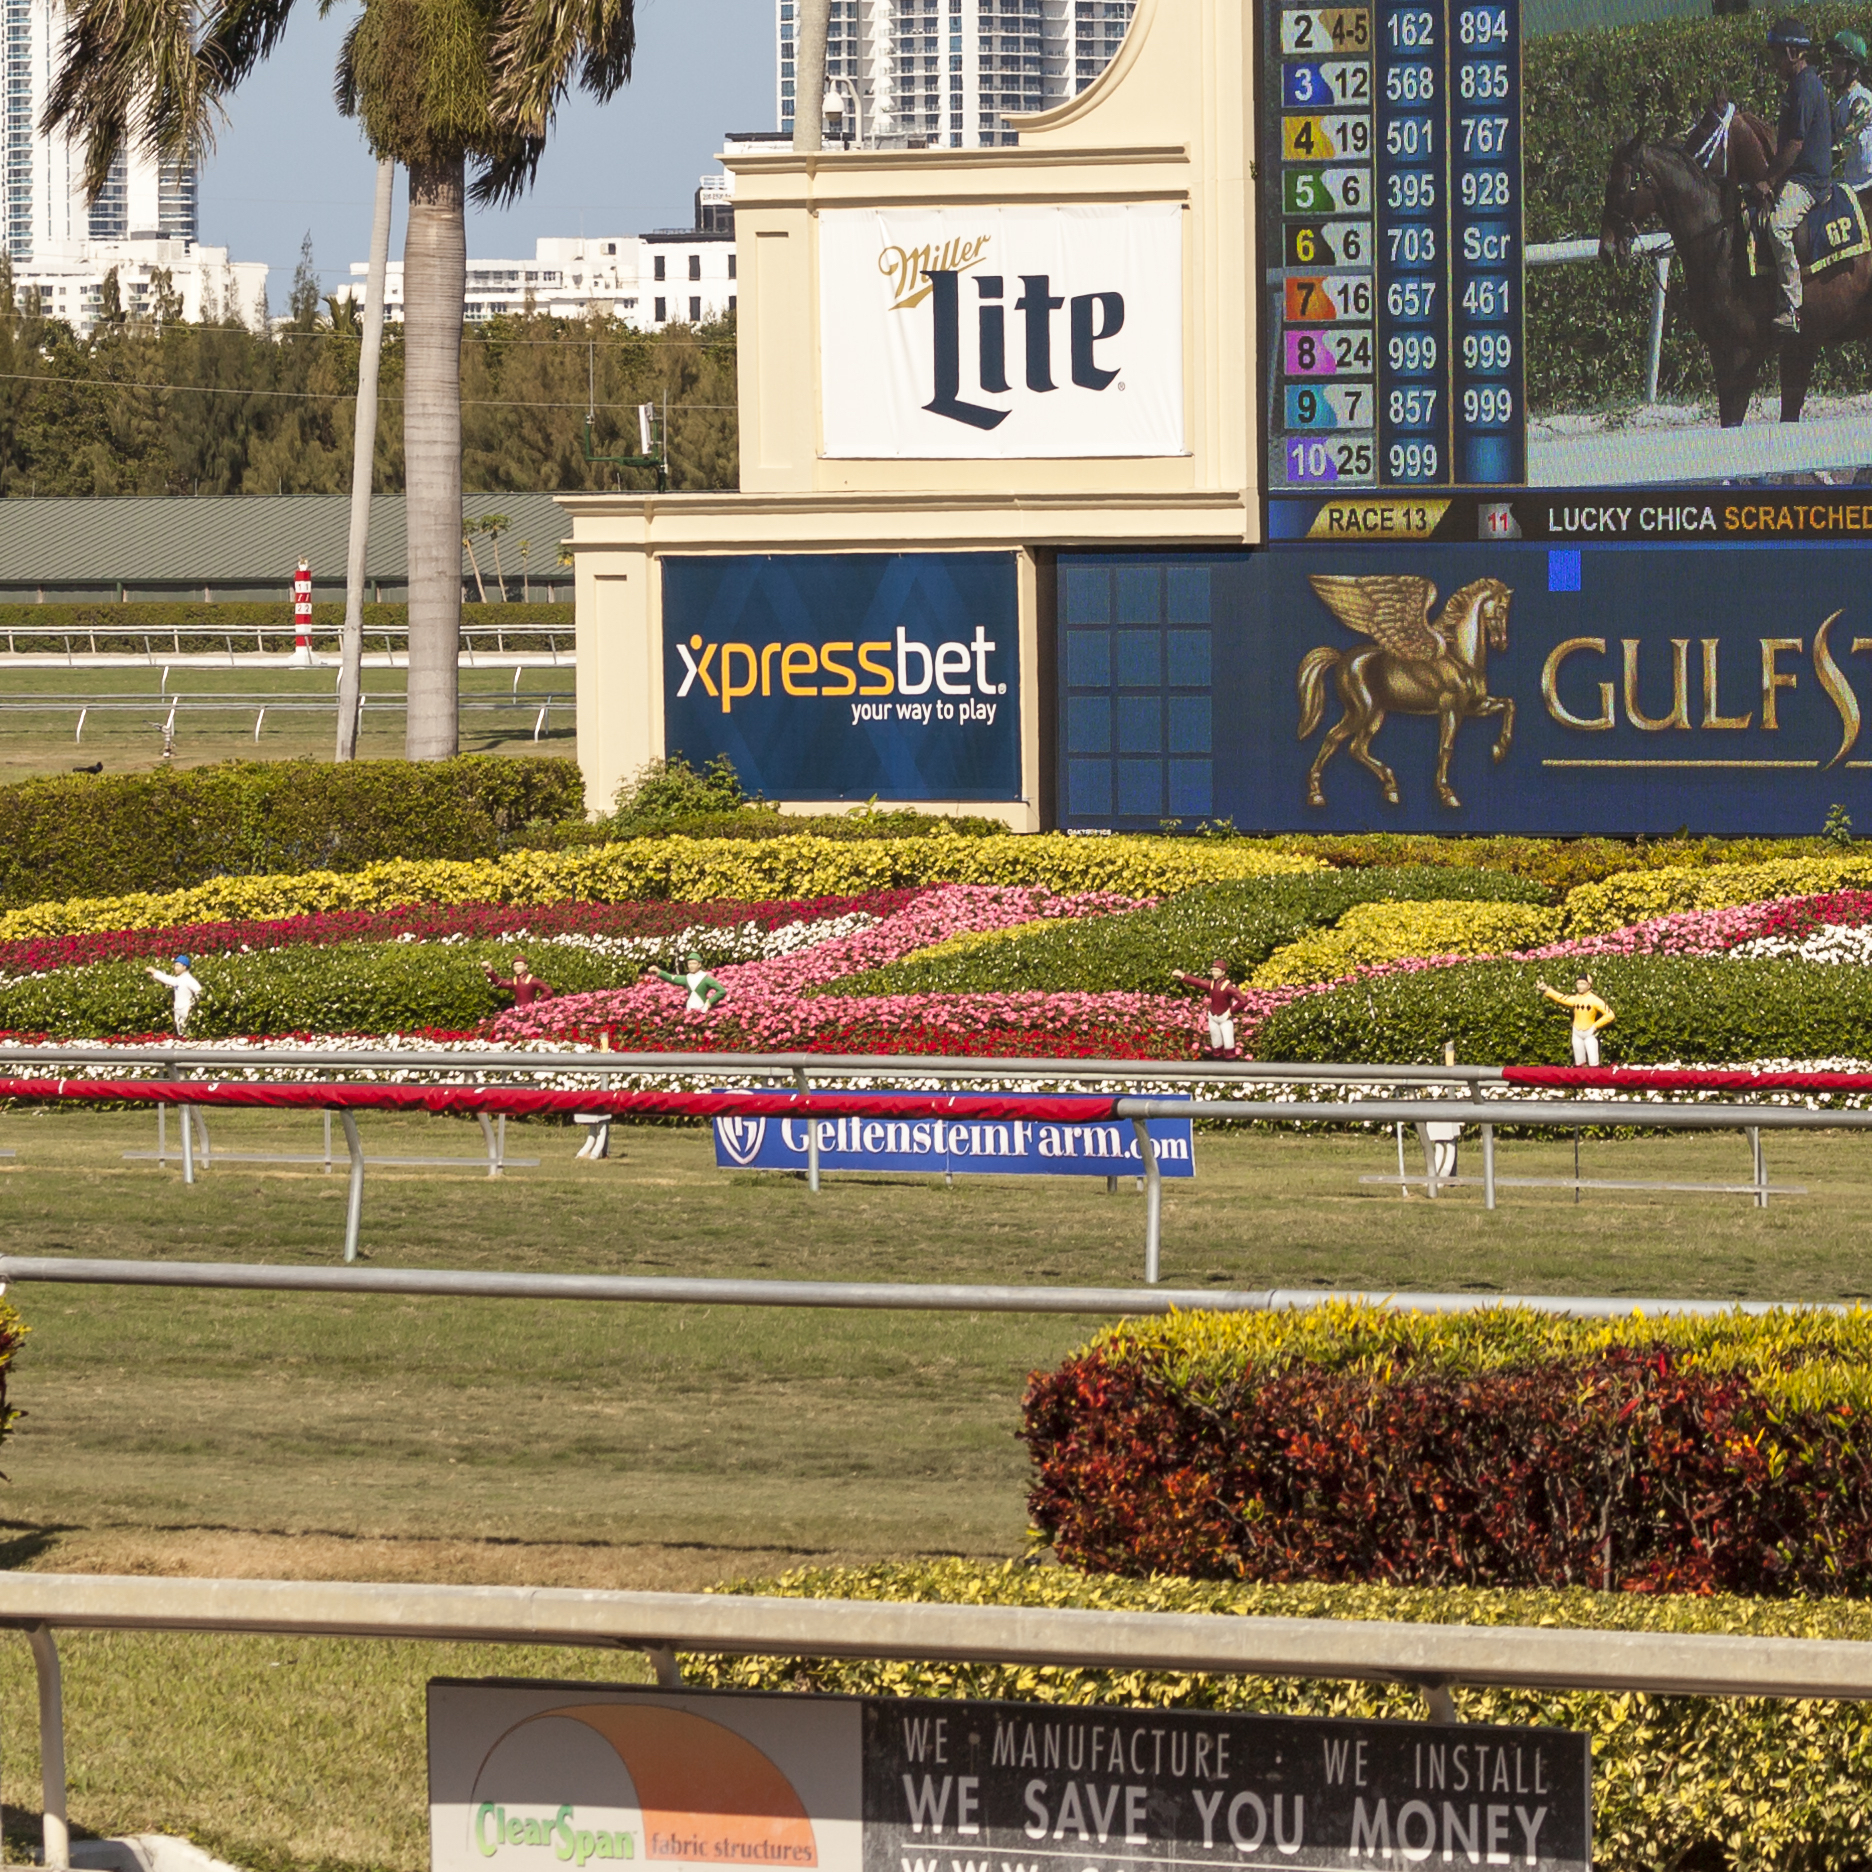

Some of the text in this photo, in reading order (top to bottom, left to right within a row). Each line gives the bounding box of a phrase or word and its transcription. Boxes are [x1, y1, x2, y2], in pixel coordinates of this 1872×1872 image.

[1293, 10, 1508, 48] 2 4-5 162 894
[1294, 65, 1509, 101] 3 12 568 835
[1293, 118, 1509, 154] 4 19 501 767
[1295, 172, 1510, 208] 5 6 395 928
[1295, 226, 1511, 262] 6 6 703 Scr
[878, 234, 991, 306] Miller
[1296, 280, 1510, 316] 7 16 657 461
[919, 270, 1125, 431] Lite
[1297, 334, 1512, 370] 8 24 999 999
[1297, 388, 1512, 424] 9 7 857 999
[1291, 443, 1438, 478] 10 25 999
[1329, 507, 1394, 532] RACE
[1405, 507, 1427, 530] 13
[1487, 512, 1509, 532] 11
[1548, 508, 1633, 532] LUCKY
[1640, 506, 1717, 531] CHICA
[676, 625, 997, 713] xpressbet
[851, 698, 997, 726] your way to play
[903, 1717, 1548, 1795] WE MANUFACTURE WE INSTALL
[475, 1801, 634, 1867] ClearSpan
[902, 1773, 1549, 1866] WE SAVE YOU MONEY
[651, 1832, 813, 1862] fabric structures
